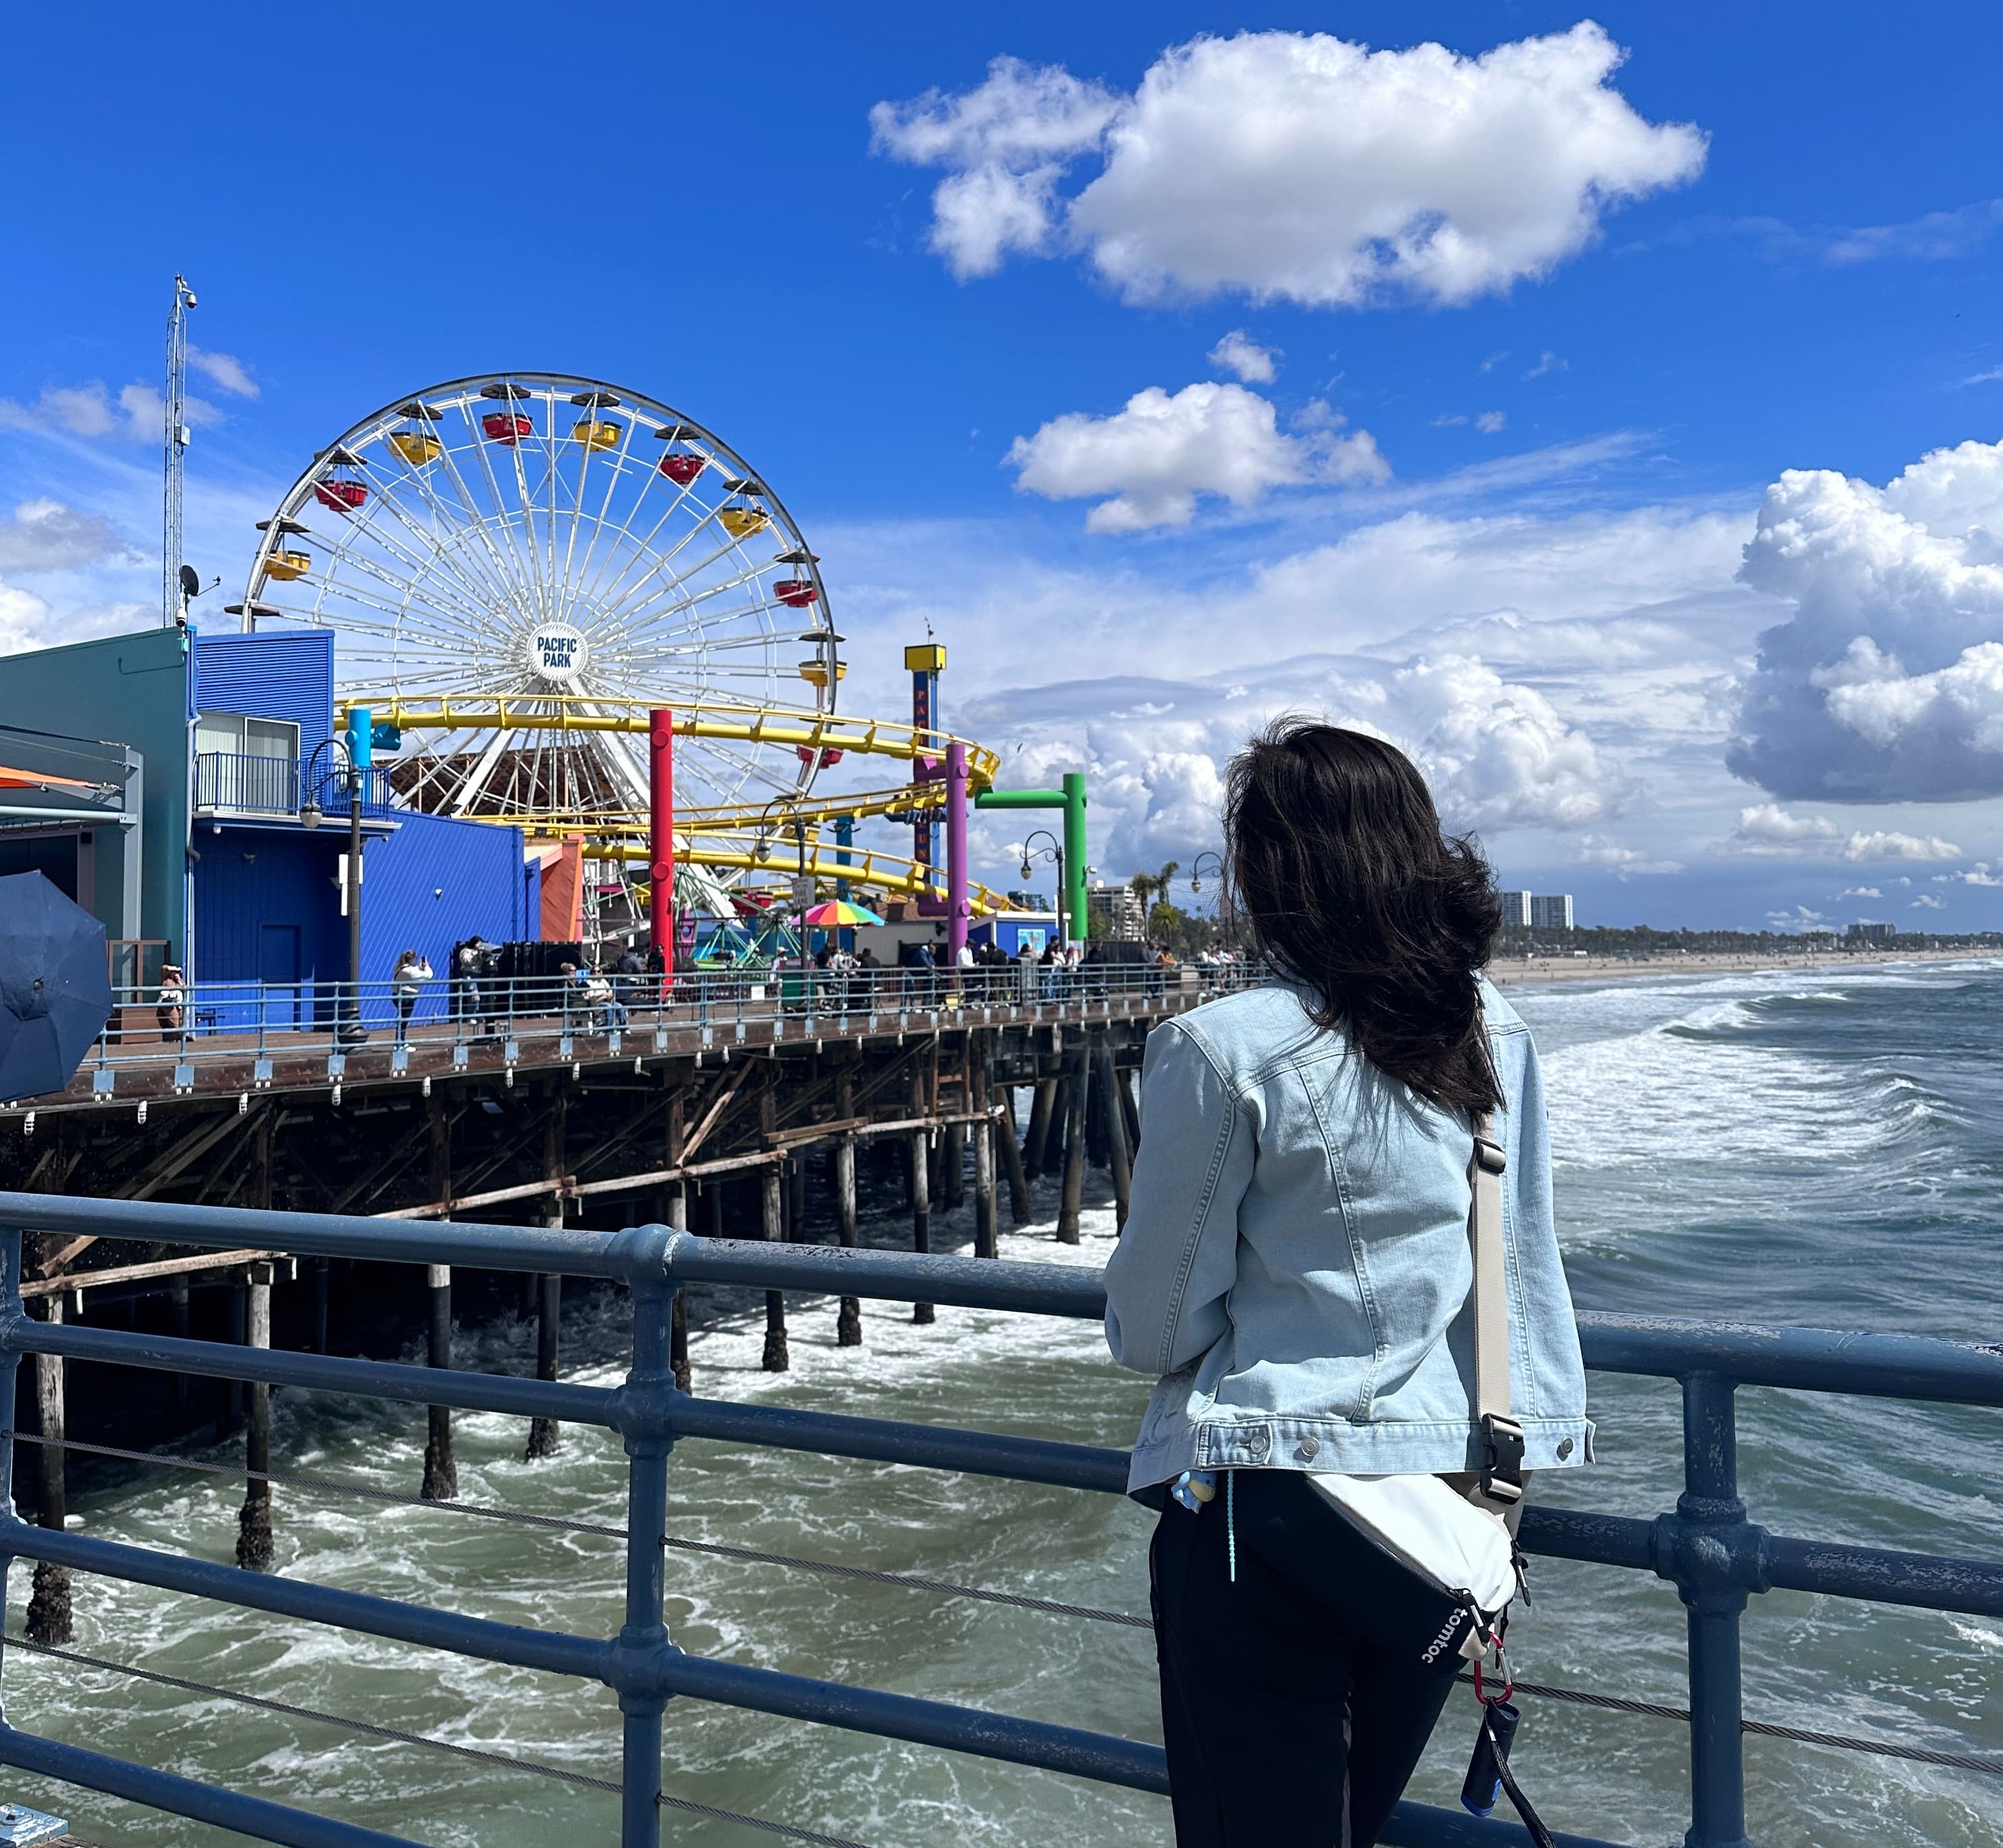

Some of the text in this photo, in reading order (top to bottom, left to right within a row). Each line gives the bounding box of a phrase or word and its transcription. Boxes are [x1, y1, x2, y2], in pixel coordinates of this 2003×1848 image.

[538, 637, 577, 652] PACIFIC
[544, 652, 571, 668] PARK
[1422, 1608, 1468, 1664] tomtoc
